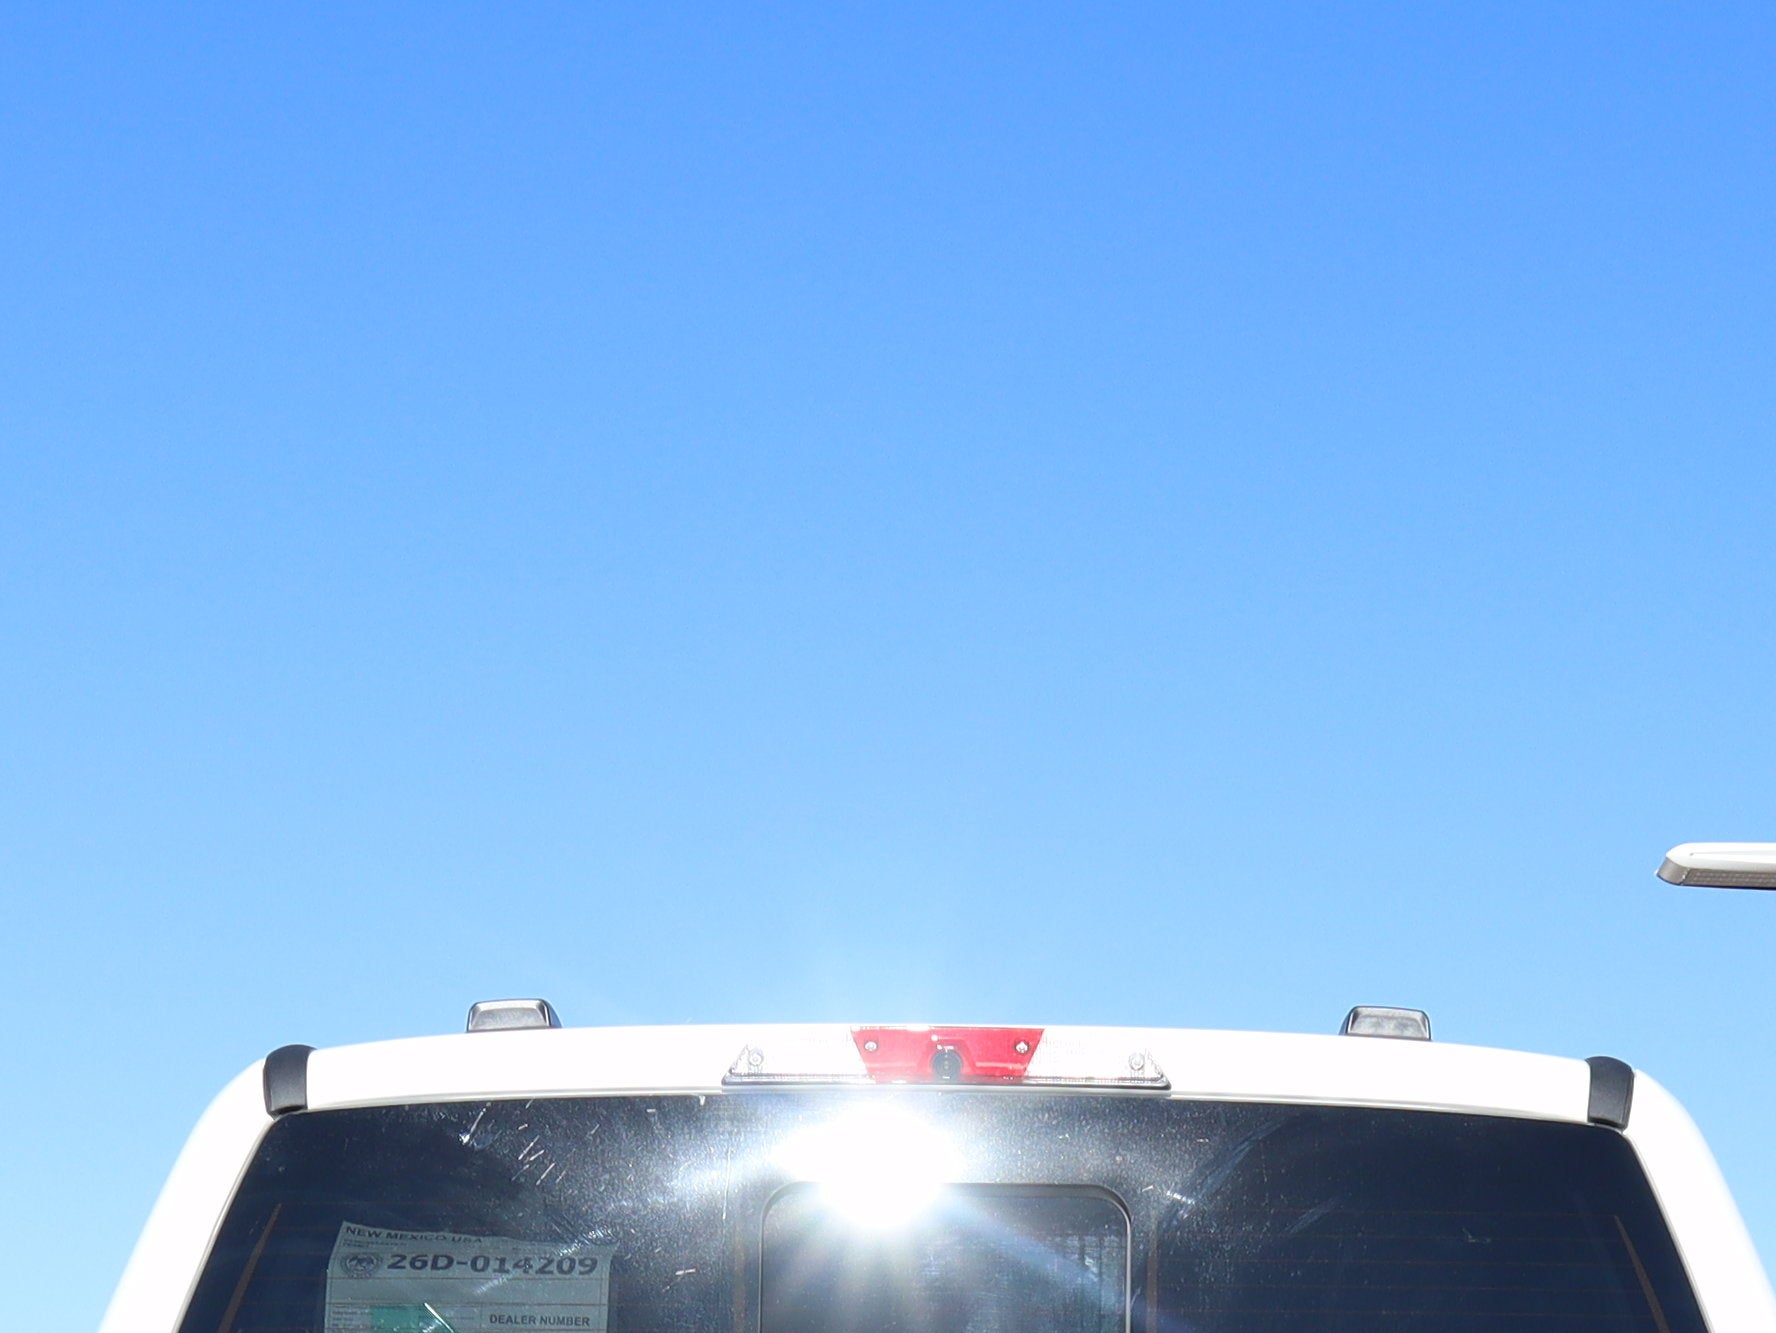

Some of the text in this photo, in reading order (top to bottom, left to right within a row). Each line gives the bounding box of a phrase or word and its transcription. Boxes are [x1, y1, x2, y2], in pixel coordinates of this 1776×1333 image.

[345, 1225, 483, 1244] NEW MEXICO USA
[387, 1254, 598, 1275] 26D-014209
[489, 1314, 590, 1327] DEALER NUMBER
